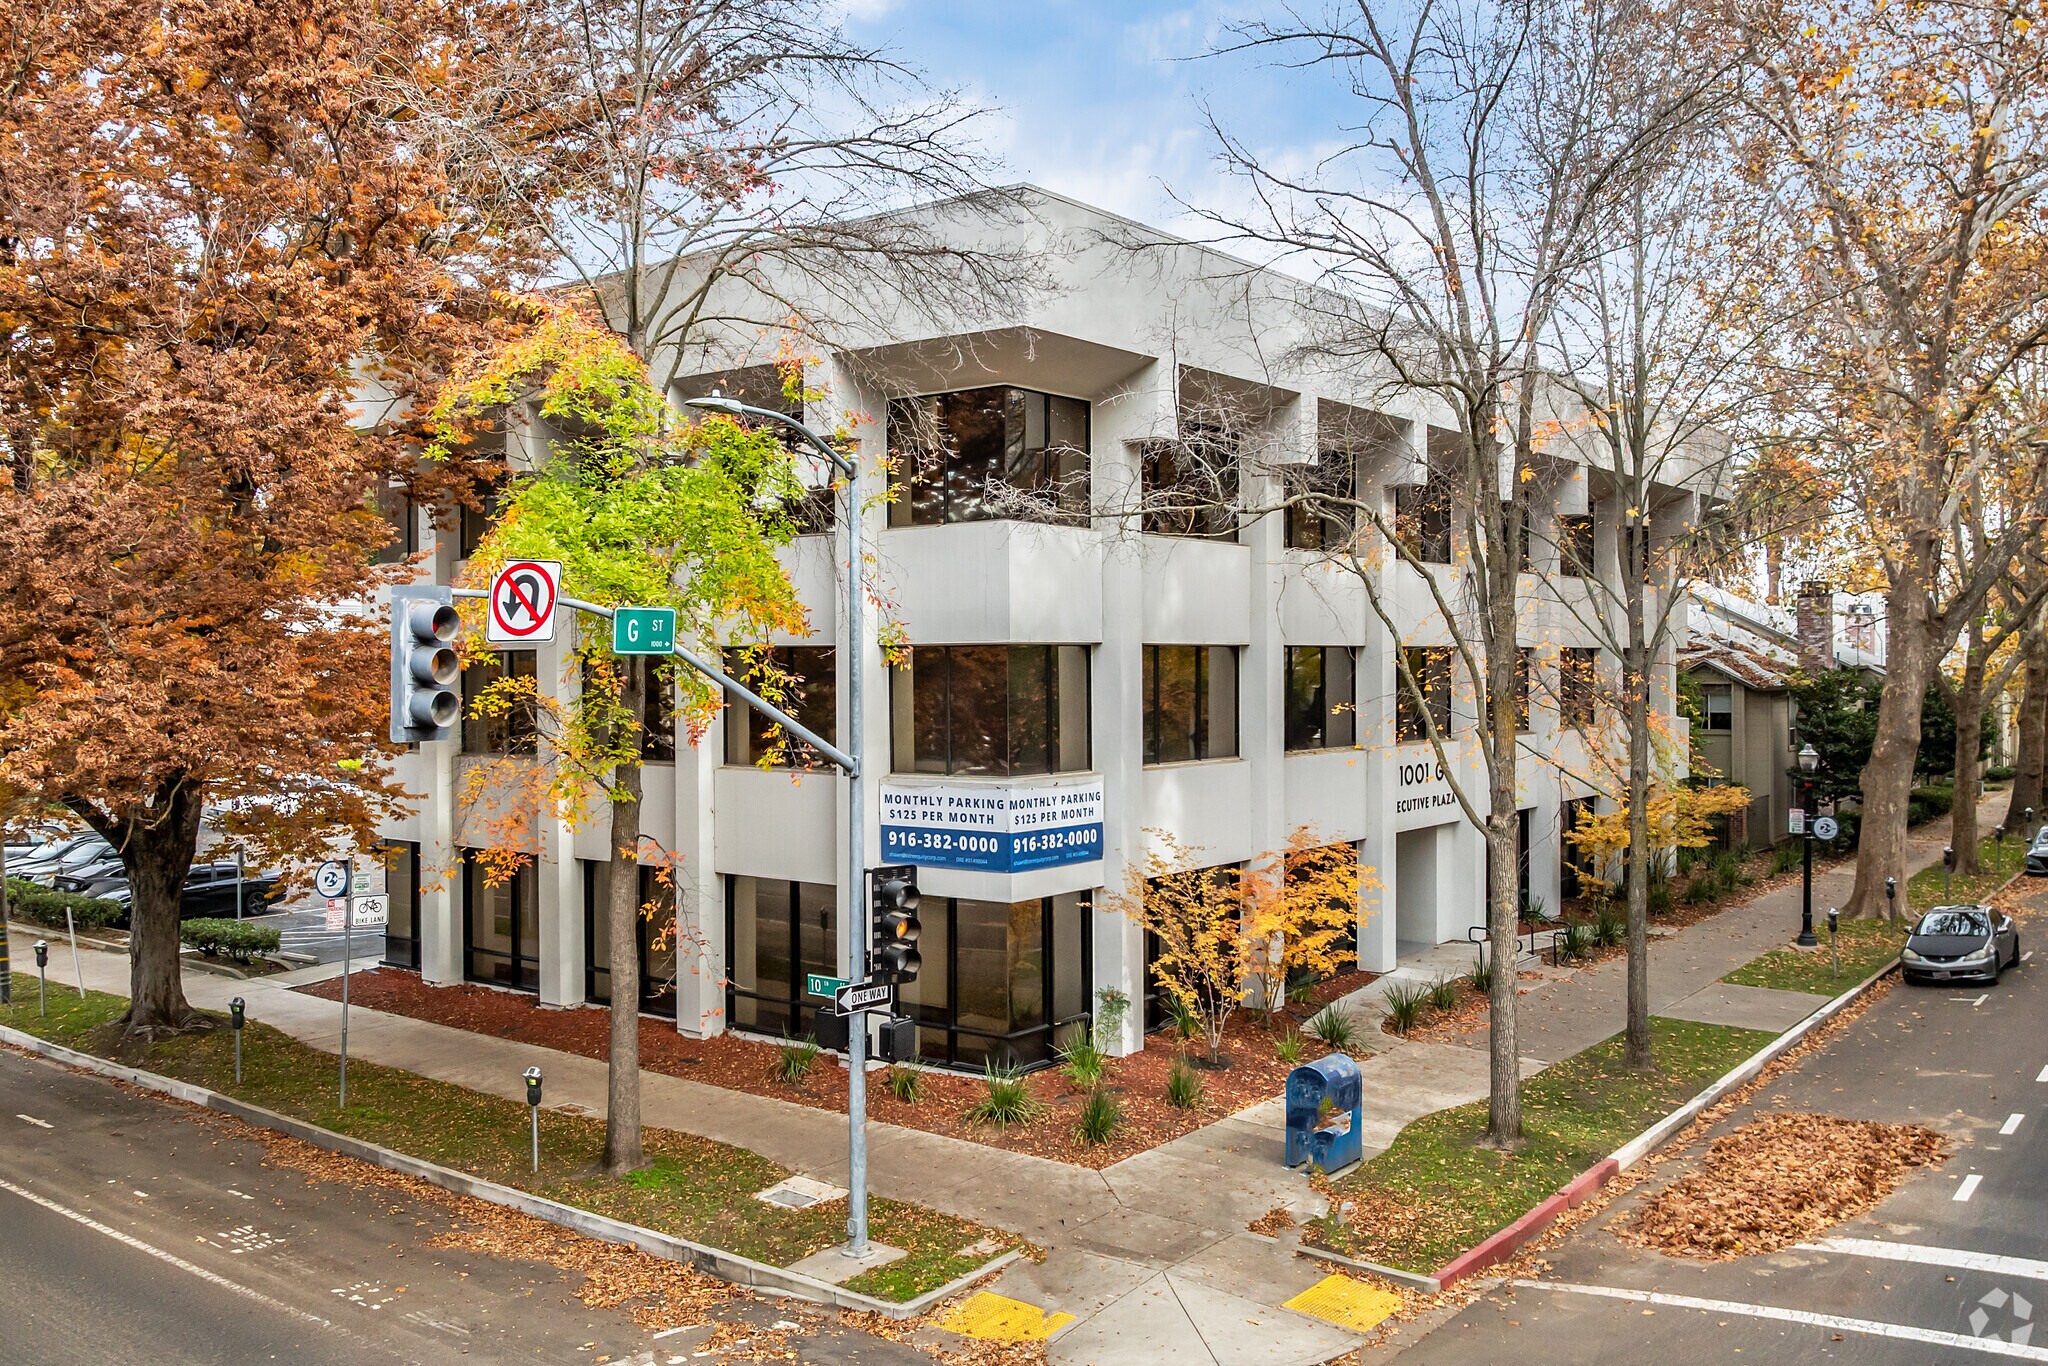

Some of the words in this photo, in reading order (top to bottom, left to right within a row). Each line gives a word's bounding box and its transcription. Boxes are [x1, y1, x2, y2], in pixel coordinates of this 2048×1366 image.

[627, 618, 639, 642] G
[652, 619, 664, 631] ST
[1399, 762, 1430, 787] 1001
[1435, 761, 1445, 781] G
[884, 794, 943, 806] MONTHLY
[948, 797, 1004, 810] PARKING
[1009, 796, 1057, 810] MONTHLY
[1061, 791, 1101, 805] PARKING
[1396, 796, 1430, 813] ECUTIVE
[1432, 793, 1456, 807] PLAZA
[889, 809, 917, 820] $125
[922, 811, 943, 822] PER
[948, 812, 994, 825] MONTH
[1014, 813, 1037, 825] $125
[1040, 811, 1057, 822] PER
[1061, 807, 1094, 820] MONTH
[888, 831, 998, 853] 916-382-0000
[1013, 828, 1097, 854] 916-382-0000
[355, 917, 368, 925] BIKE
[370, 916, 385, 924] LANE
[810, 978, 822, 992] 10
[851, 990, 867, 1004] ONE
[869, 987, 887, 1000] WAY
